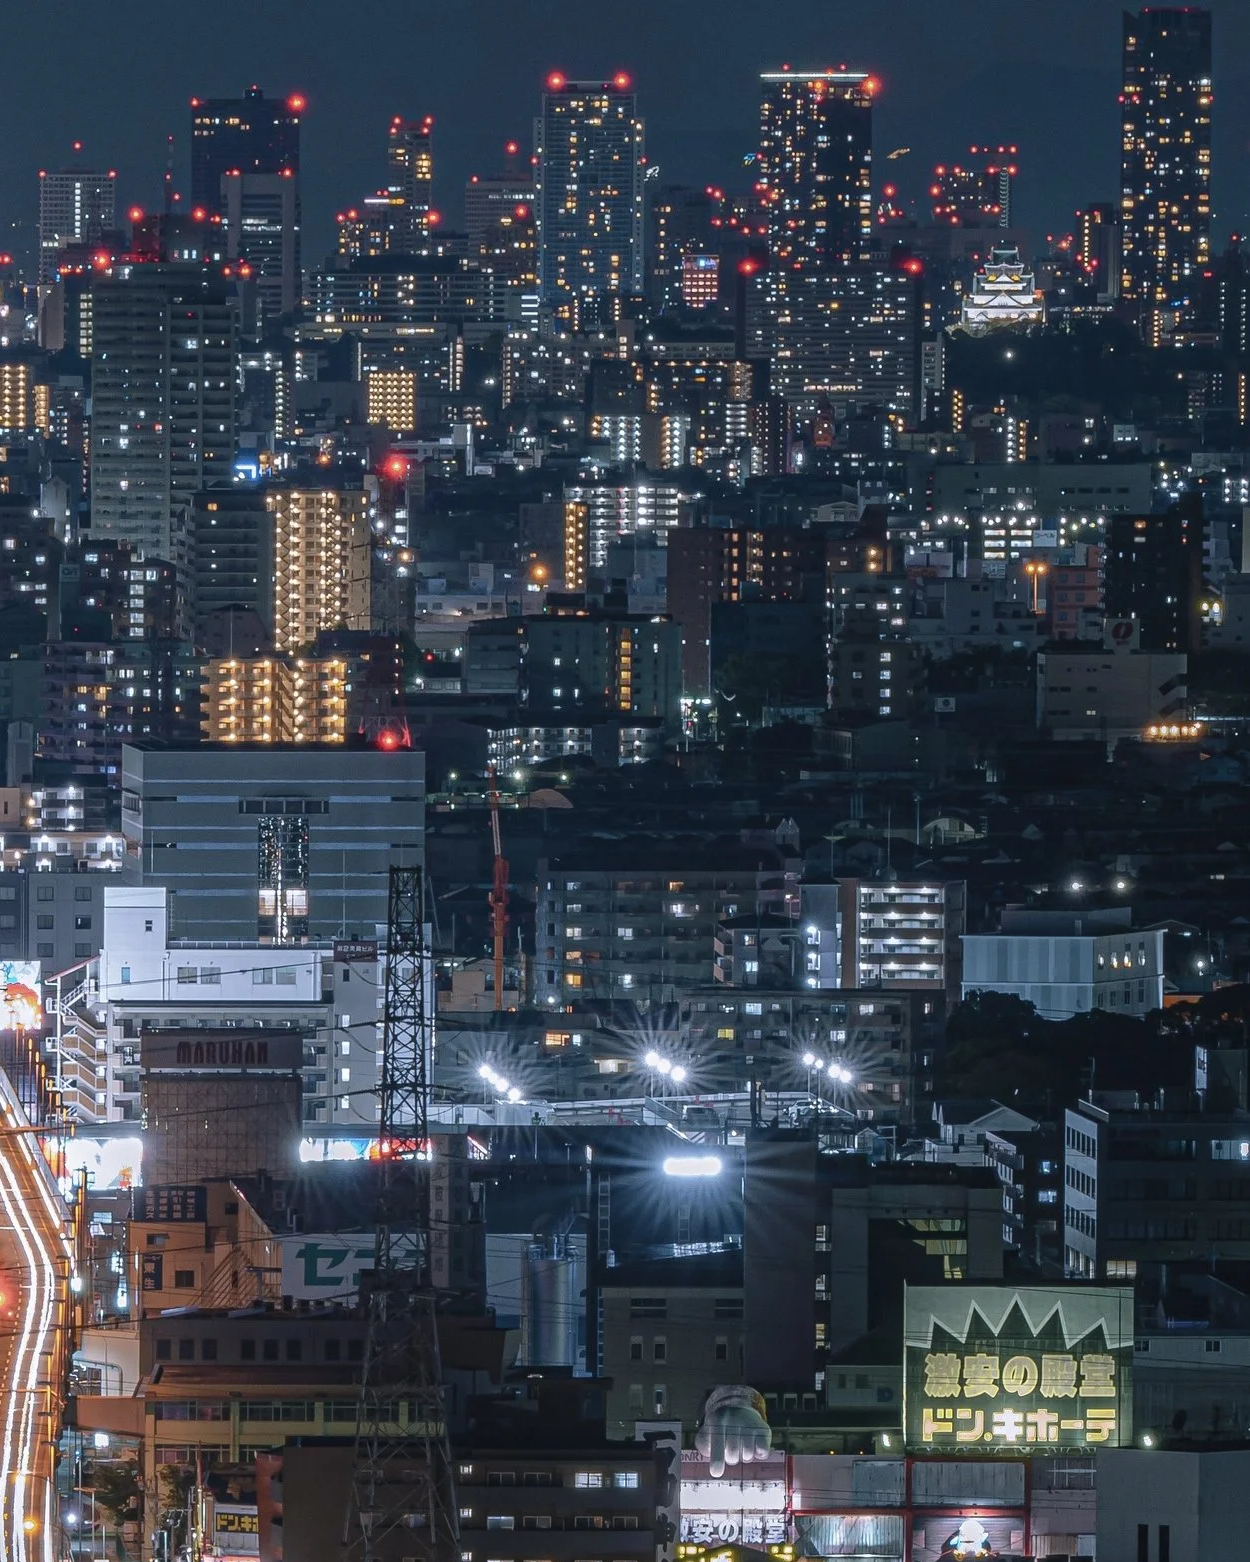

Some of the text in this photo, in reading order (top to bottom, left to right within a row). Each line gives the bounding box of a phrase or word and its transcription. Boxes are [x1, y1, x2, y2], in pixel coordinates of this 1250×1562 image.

[176, 1041, 268, 1064] MARUHAN
[923, 1352, 1117, 1398] 激安の殿堂
